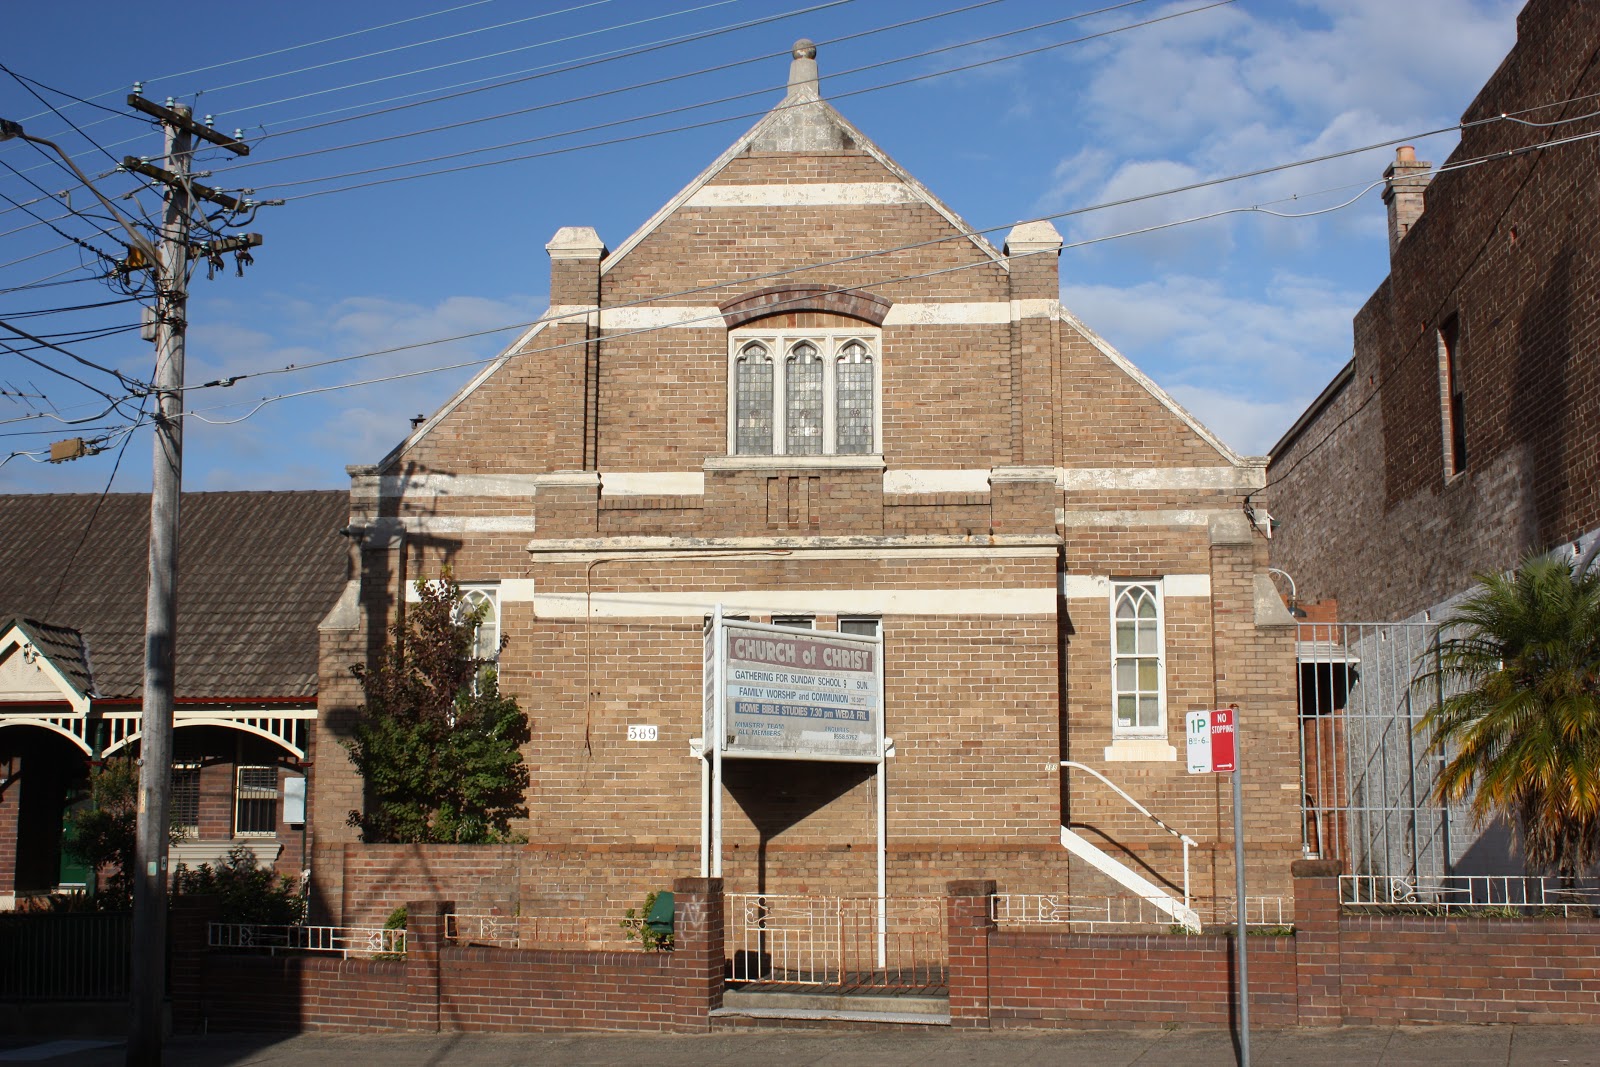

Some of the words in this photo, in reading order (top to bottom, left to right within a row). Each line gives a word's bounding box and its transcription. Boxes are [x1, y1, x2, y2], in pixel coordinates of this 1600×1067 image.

[735, 638, 796, 662] CHURCH
[802, 646, 816, 664] of
[823, 648, 868, 670] CHRIST
[735, 670, 774, 682] GATHERING
[776, 674, 788, 682] FOR
[790, 674, 816, 684] SUNDAY
[818, 677, 842, 687] SCHOOL
[739, 687, 764, 697] FAMILY
[766, 689, 796, 699] WORSHIP
[812, 692, 848, 703] COMMUNION
[739, 703, 760, 713] HOME
[762, 704, 780, 714] BIBLE
[782, 706, 808, 716] STUDIES
[810, 708, 822, 717] 7.30
[1217, 713, 1226, 723] NO
[630, 727, 656, 739] 389
[1191, 719, 1206, 733] 1P
[1212, 725, 1232, 734] STOPPING
